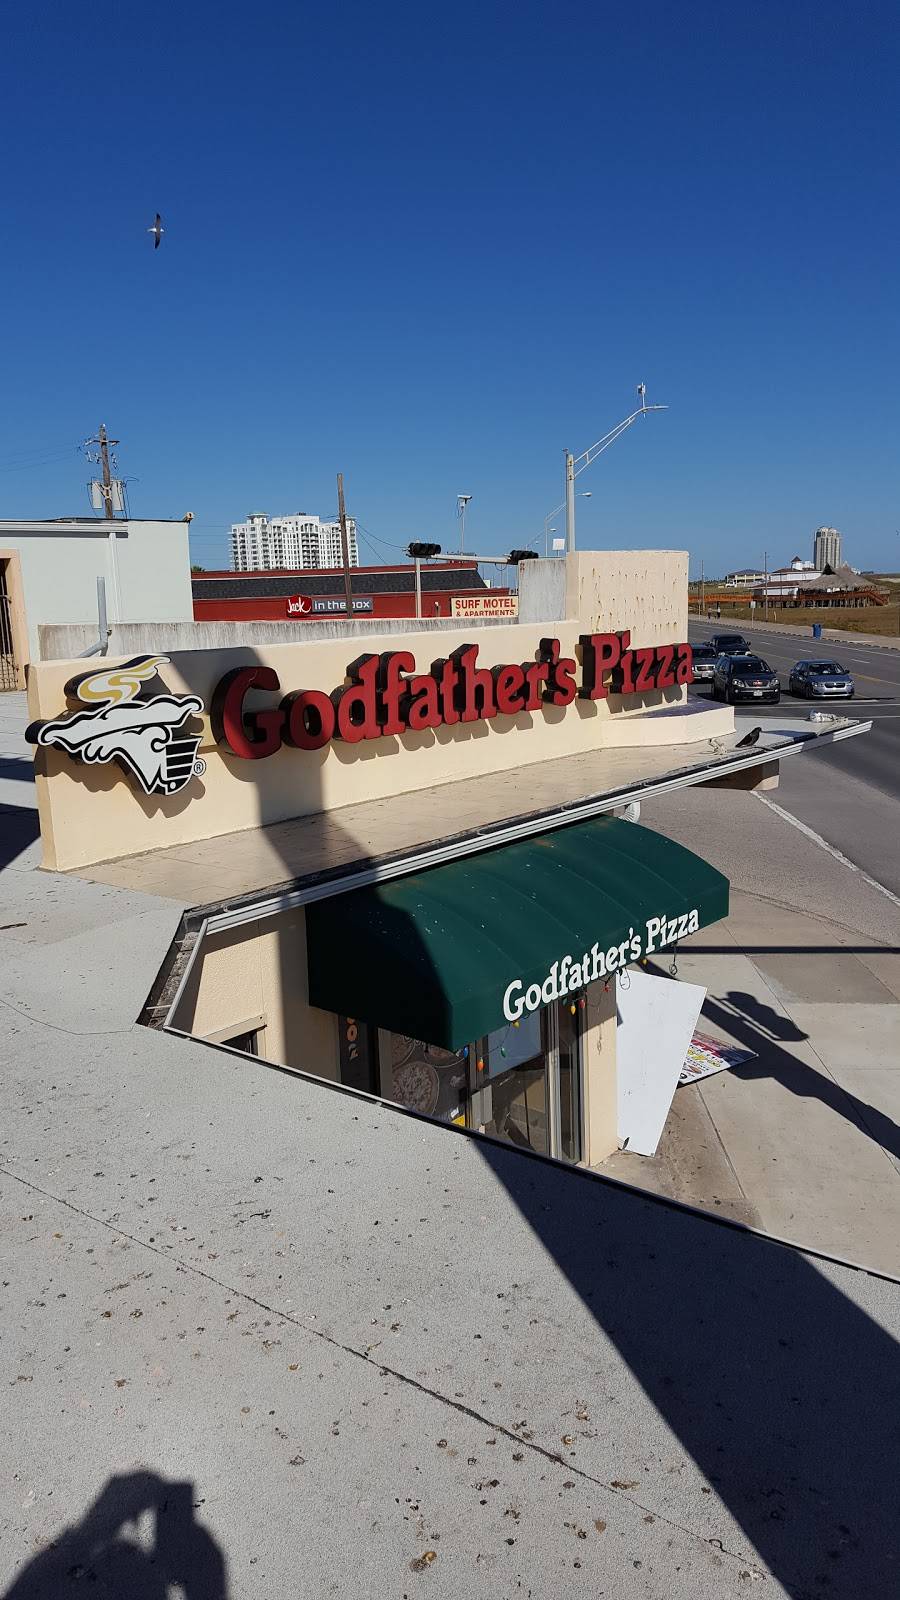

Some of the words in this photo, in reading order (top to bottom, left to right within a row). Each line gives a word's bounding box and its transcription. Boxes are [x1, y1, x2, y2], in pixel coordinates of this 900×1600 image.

[287, 596, 312, 613] Jack
[314, 600, 325, 610] in
[327, 600, 346, 610] the
[455, 599, 480, 609] SURF
[483, 598, 516, 608] MOTEL
[464, 609, 515, 617] APARTMENTS
[217, 637, 576, 760] Godfather's
[587, 629, 694, 701] Pizza
[503, 927, 642, 1022] Godfather's
[645, 908, 700, 954] Pizza
